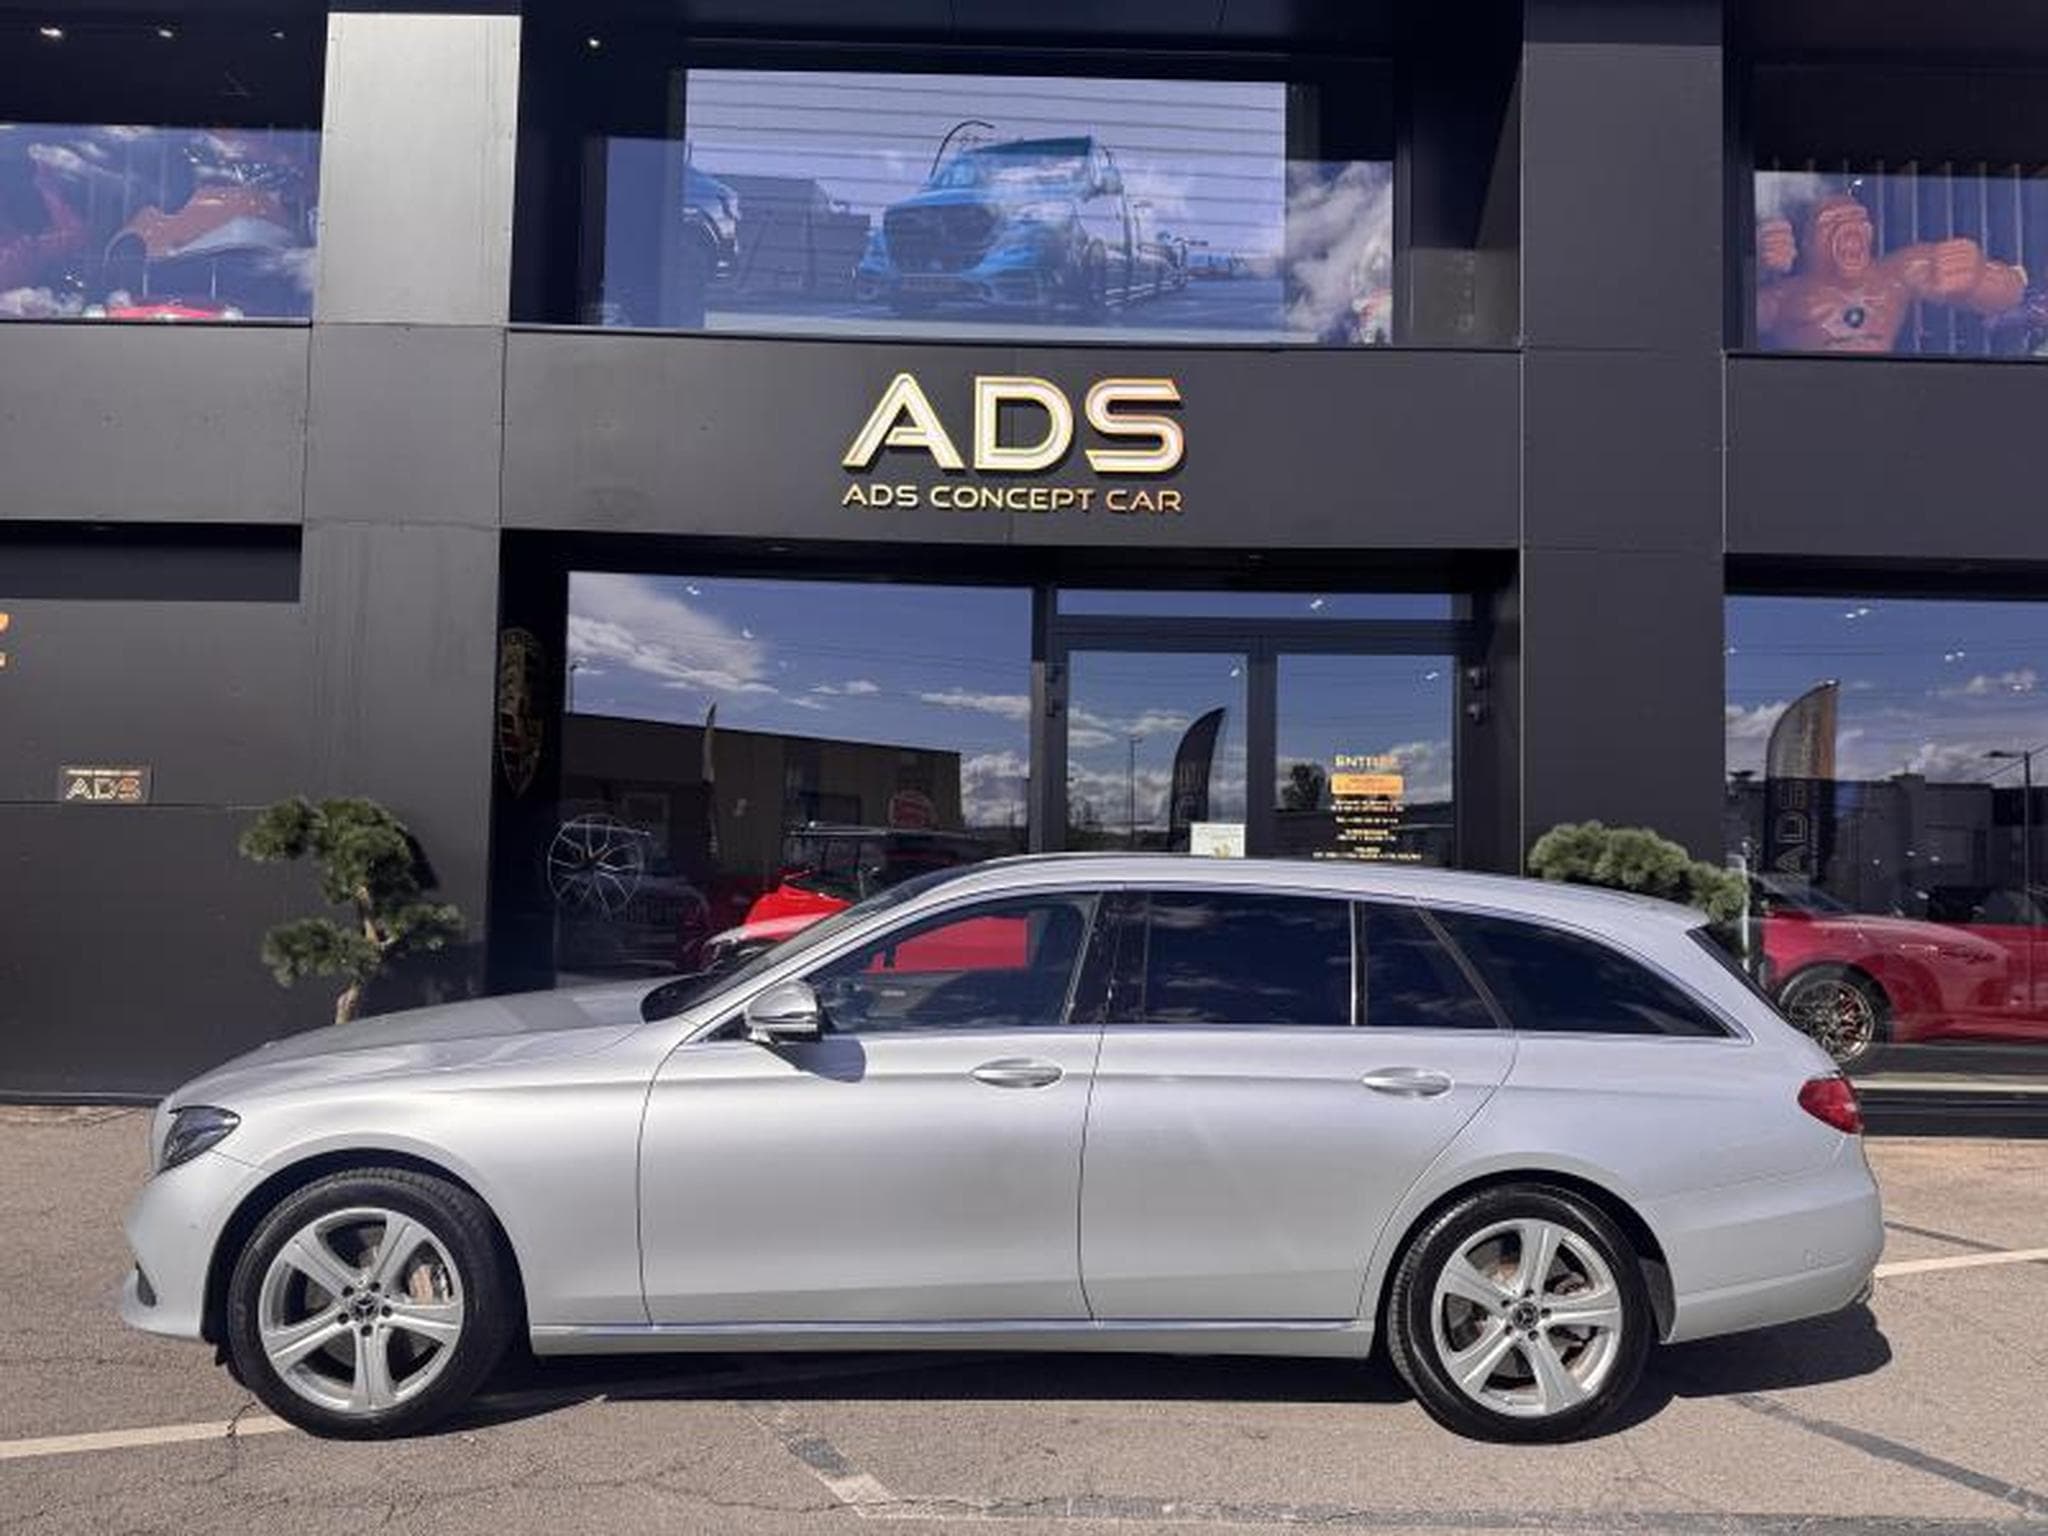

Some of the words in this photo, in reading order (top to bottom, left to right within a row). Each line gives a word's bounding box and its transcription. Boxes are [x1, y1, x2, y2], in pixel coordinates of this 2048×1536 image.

[842, 373, 1185, 473] ADS
[842, 483, 918, 508] ADS
[930, 486, 1094, 512] CONCEPT
[1105, 490, 1182, 512] CAR
[66, 778, 141, 799] ADS
